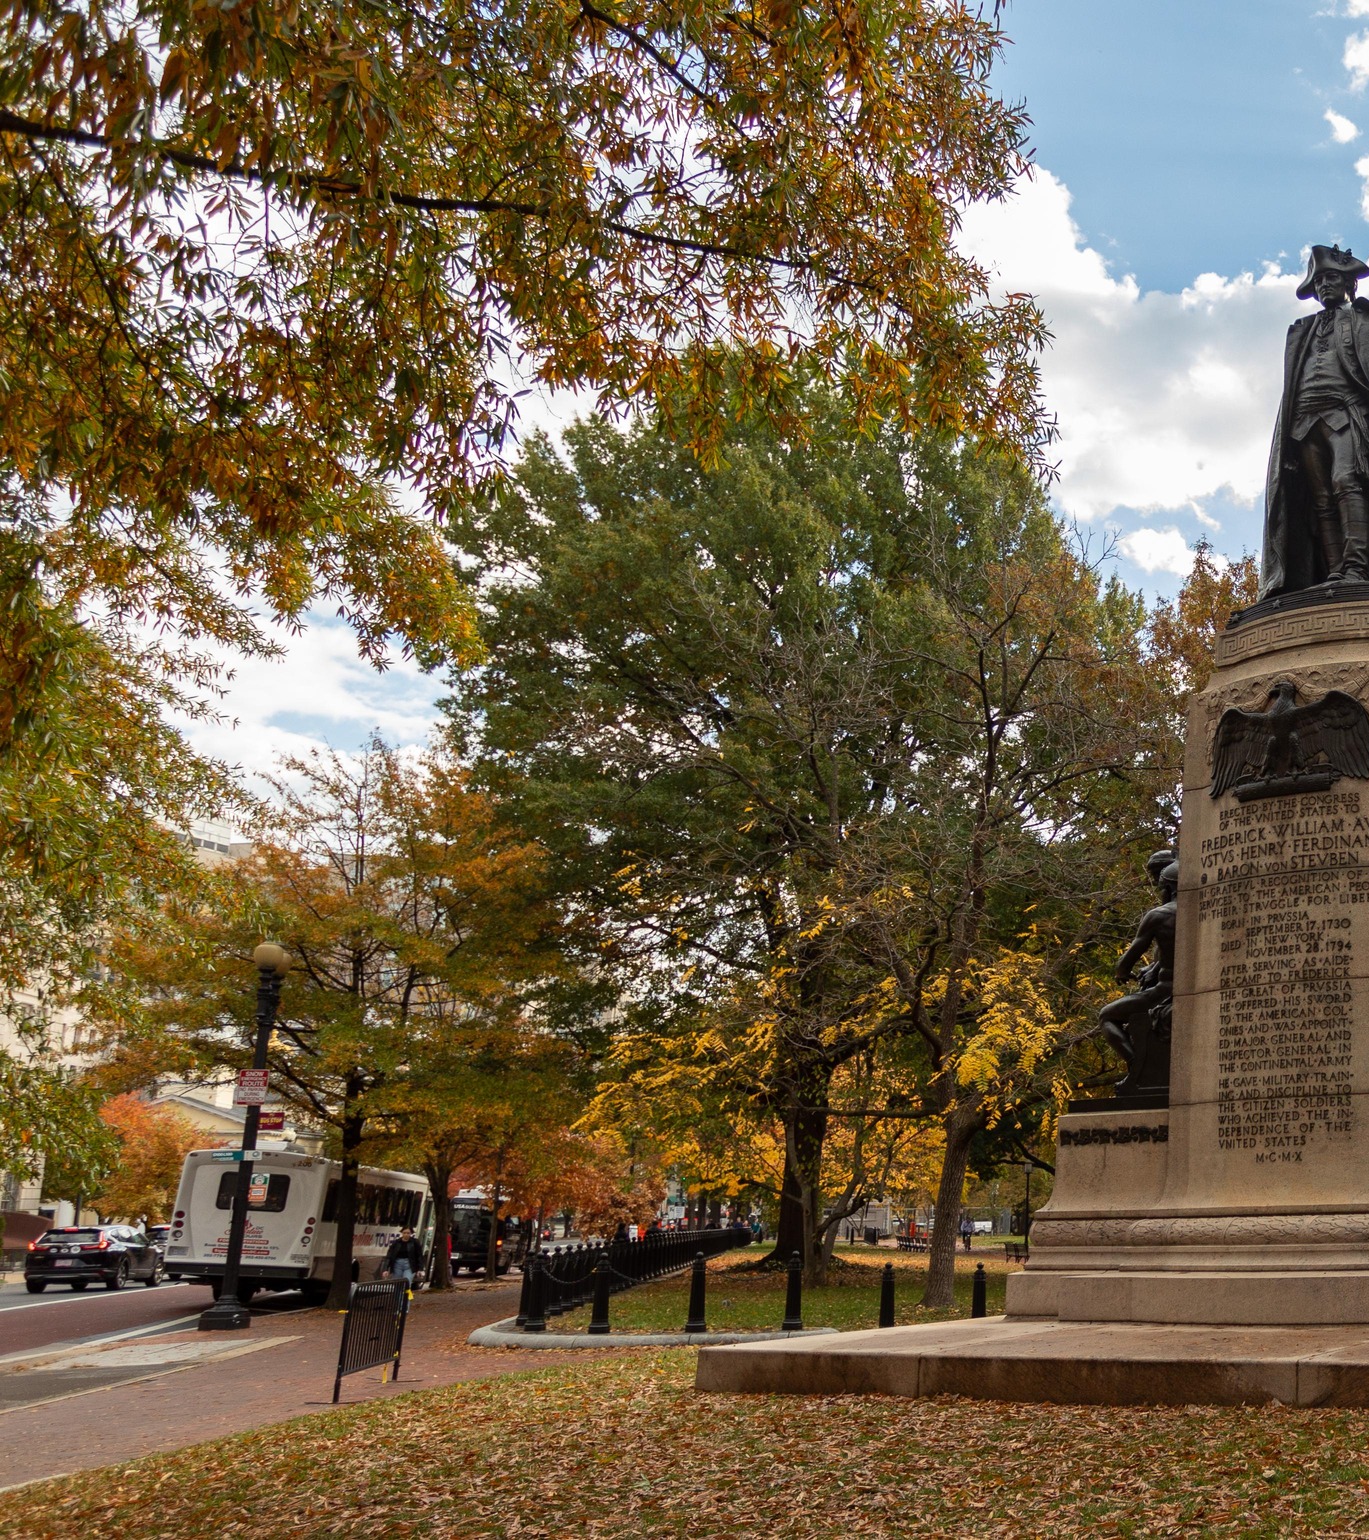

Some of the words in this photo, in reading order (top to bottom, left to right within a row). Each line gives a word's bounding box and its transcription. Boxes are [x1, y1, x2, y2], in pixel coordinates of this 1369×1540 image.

[1220, 804, 1258, 821] ERECTED
[1261, 803, 1273, 811] BY
[1277, 800, 1297, 810] THE
[1300, 793, 1360, 806] CONGRESS
[1219, 820, 1230, 831] OF
[1234, 816, 1251, 828] THE
[1255, 810, 1295, 823] VNITED
[1300, 806, 1338, 817] STATES
[1343, 803, 1360, 813] TO
[1201, 827, 1266, 853] FREDERICK
[1272, 819, 1344, 837] WILLIAM
[1201, 850, 1234, 869] VSTVS
[1241, 841, 1286, 861] HENRY
[1218, 861, 1260, 881] BARON
[1290, 851, 1359, 870] STEVBEN
[1200, 890, 1207, 899] IN
[1260, 871, 1339, 887] RECOGNITION
[1346, 870, 1362, 880] OF
[1199, 896, 1232, 910] SERVICES
[1238, 893, 1249, 903] TO
[1256, 889, 1280, 899] THE
[1281, 884, 1340, 897] AMERICAN
[1199, 910, 1206, 920] IN
[1211, 906, 1238, 918] THEIR
[1243, 897, 1299, 914] STRVGGLE
[1307, 895, 1331, 905] FOR
[1221, 918, 1245, 930] BORN
[1251, 916, 1260, 925] IN
[1267, 911, 1309, 924] PRVSSIA
[1246, 923, 1301, 937] SEPTEMBER
[1221, 940, 1241, 952] DIED
[1247, 938, 1257, 948] IN
[1264, 935, 1289, 945] NEW
[1294, 932, 1324, 942] YORK
[1246, 945, 1301, 959] NOVEMBER
[1221, 964, 1248, 977] AFTER
[1252, 958, 1296, 973] SERVING
[1302, 958, 1316, 967] AS
[1221, 978, 1231, 988] DE
[1234, 973, 1261, 985] CAMP
[1268, 972, 1281, 983] TO
[1288, 967, 1350, 980] FREDERICK
[1220, 990, 1236, 1001] THE
[1242, 986, 1274, 998] GREAT
[1281, 984, 1296, 994] OF
[1303, 981, 1352, 993] PRVSSIA
[1220, 1004, 1230, 1013] HE
[1235, 998, 1277, 1011] OFFERED
[1283, 996, 1300, 1006] HIS
[1307, 993, 1351, 1005] SWORD
[1220, 1016, 1231, 1025] TO
[1236, 1012, 1253, 1022] THE
[1258, 1007, 1315, 1021] AMERICAN
[1220, 1025, 1244, 1037] ONIES
[1248, 1023, 1269, 1034] AND
[1273, 1020, 1295, 1031] WAS
[1219, 1039, 1230, 1049] ED
[1234, 1034, 1267, 1046] MAJOR
[1270, 1032, 1323, 1045] GENERAL
[1326, 1031, 1351, 1041] AND
[1218, 1047, 1271, 1061] INSPECTOR
[1276, 1043, 1331, 1057] GENERAL
[1339, 1043, 1351, 1053] IN
[1219, 1063, 1235, 1073] THE
[1240, 1058, 1314, 1072] CONTINENTAL
[1319, 1055, 1352, 1067] ARMY
[1219, 1078, 1229, 1089] HE
[1232, 1076, 1257, 1088] GAVE
[1262, 1073, 1310, 1085] MILITARY
[1219, 1091, 1234, 1100] ING
[1239, 1088, 1260, 1099] AND
[1267, 1085, 1328, 1098] DISCIPLINE
[1335, 1084, 1352, 1094] TO
[1218, 1103, 1235, 1114] THE
[1242, 1100, 1285, 1112] CITIZEN
[1294, 1095, 1352, 1108] SOLDIERS
[1218, 1115, 1241, 1125] WHO
[1245, 1110, 1299, 1123] ACHIEVED
[1306, 1109, 1328, 1120] THE
[1218, 1124, 1290, 1137] DEPENDENCE
[1300, 1123, 1315, 1133] OF
[1325, 1122, 1351, 1132] THE
[1219, 1137, 1257, 1149] VNITED
[1264, 1135, 1306, 1147] STATES
